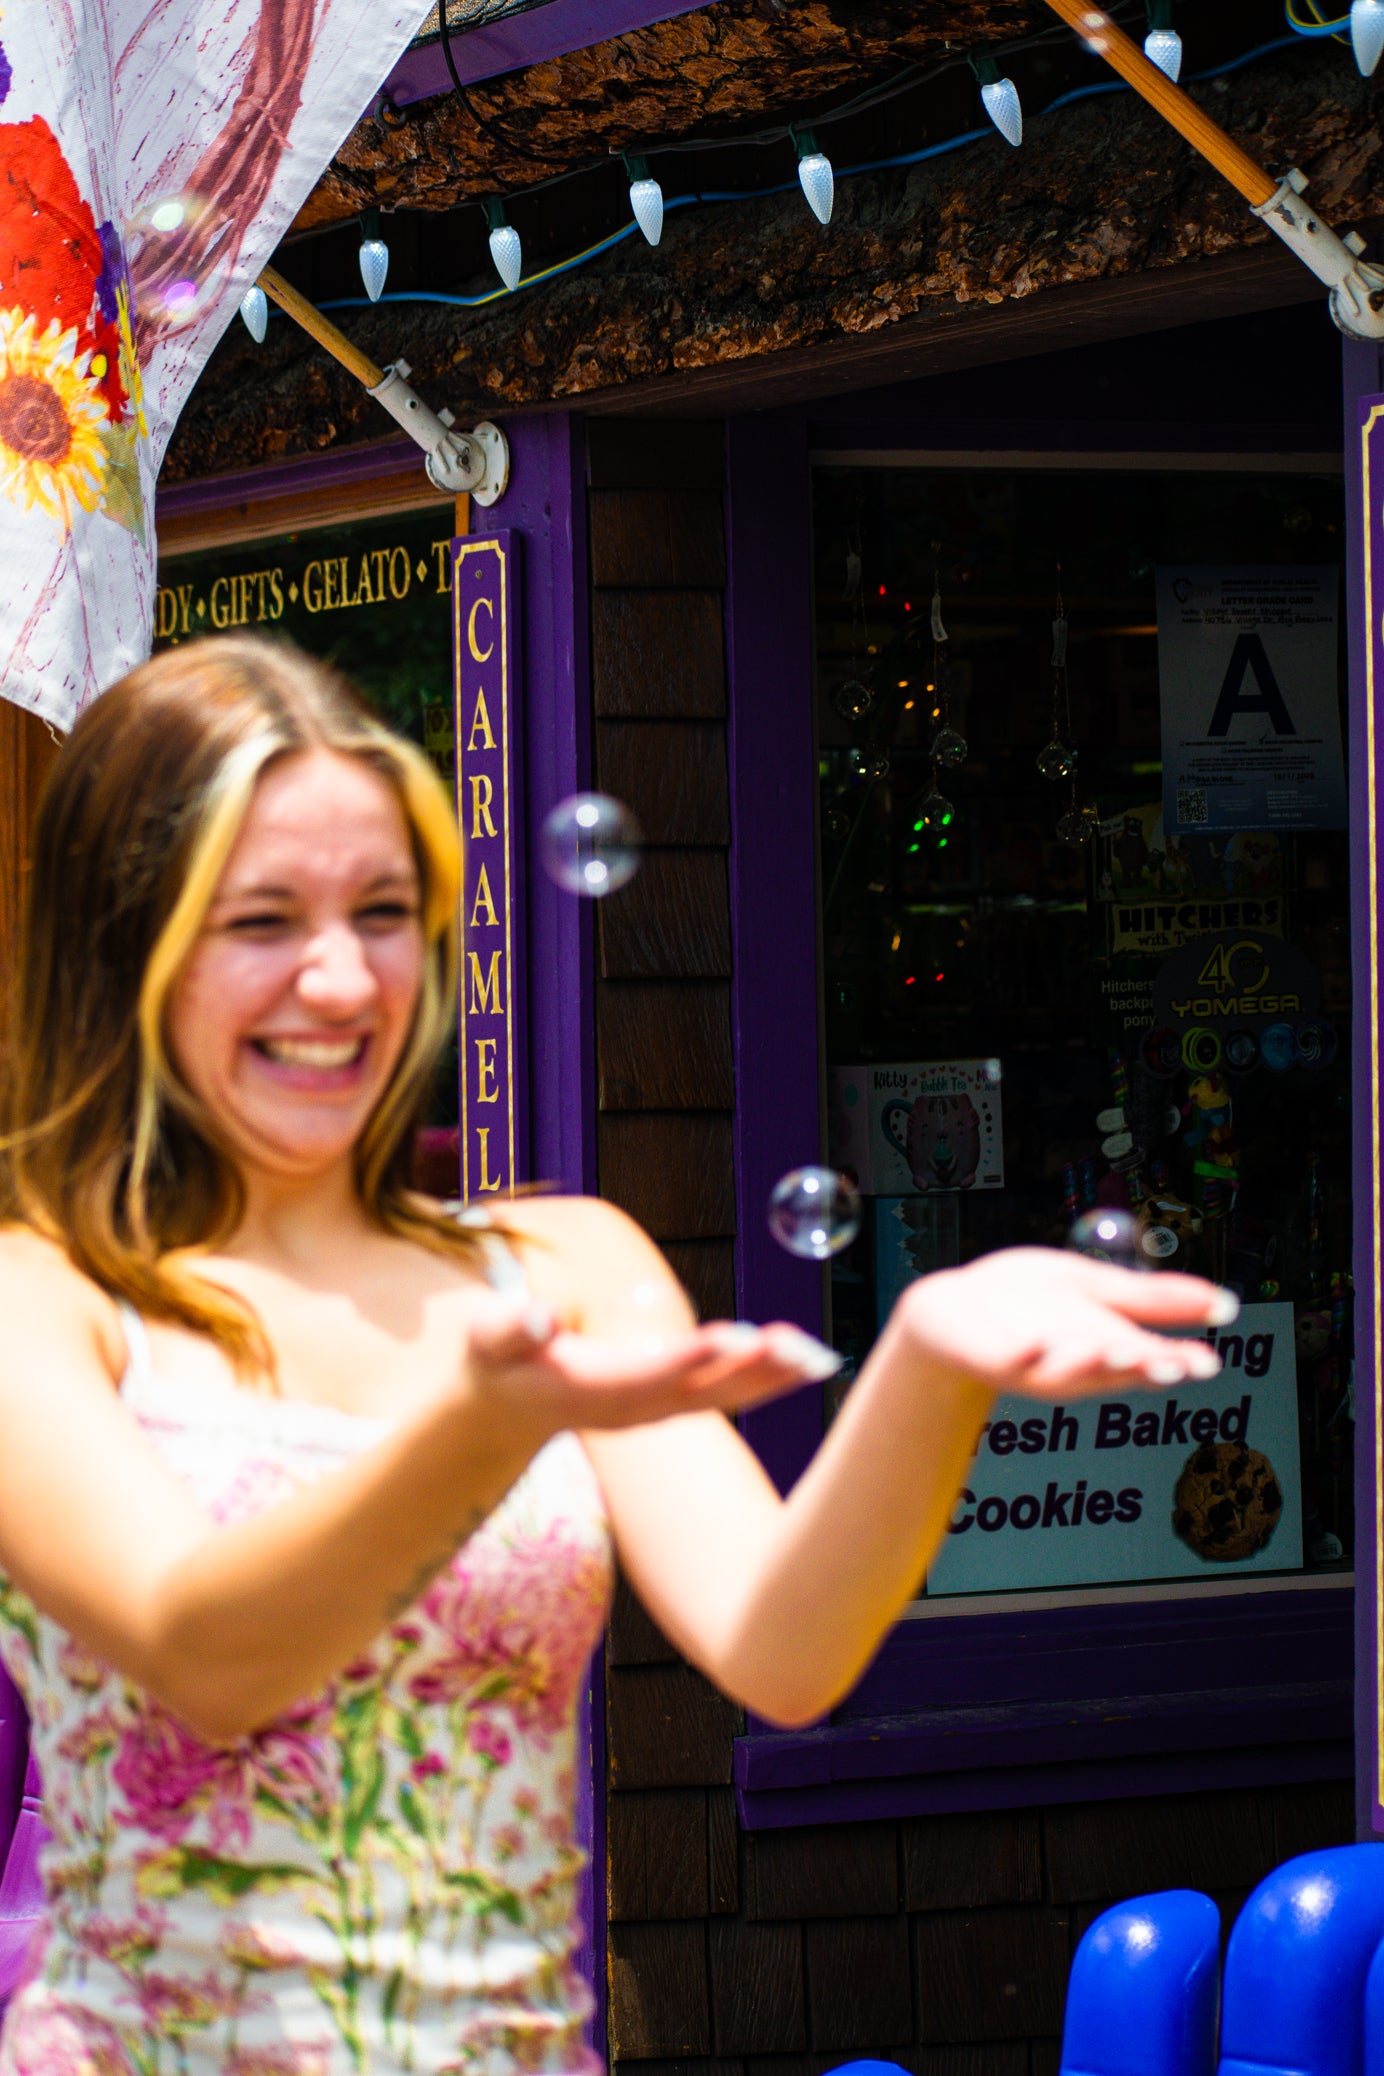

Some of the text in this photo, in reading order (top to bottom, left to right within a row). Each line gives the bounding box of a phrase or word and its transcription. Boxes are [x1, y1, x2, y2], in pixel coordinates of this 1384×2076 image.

[153, 584, 194, 637] DY
[210, 567, 284, 629] GIFTS
[303, 546, 411, 613] GELATO
[1221, 596, 1313, 605] LETTER GRADE CARD
[1208, 633, 1297, 736] A
[467, 597, 504, 1192] CARAMEL
[1118, 900, 1278, 932] HITCHERS
[1138, 931, 1170, 946] with
[1170, 993, 1301, 1019] YOMEGA
[874, 1071, 907, 1090] Kitty
[951, 1077, 967, 1091] Tea
[1095, 1395, 1252, 1449] Baked
[947, 1480, 1144, 1535] Cookies
